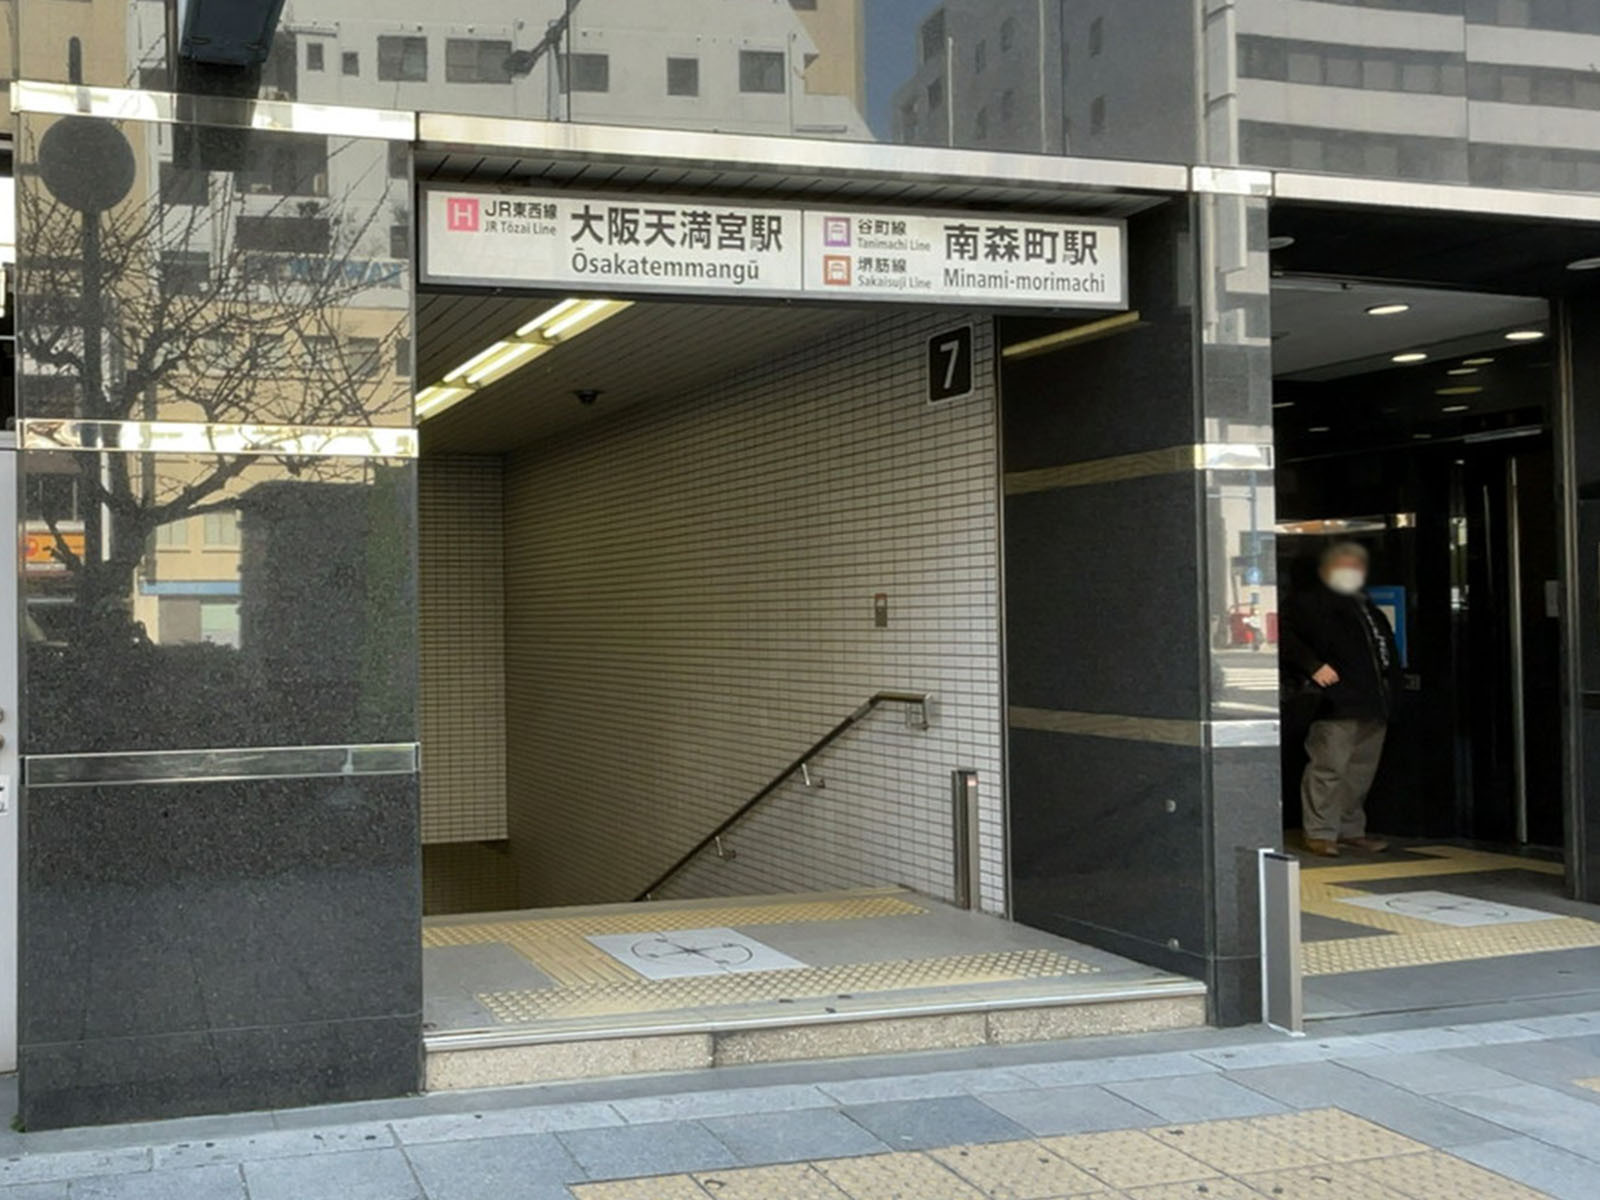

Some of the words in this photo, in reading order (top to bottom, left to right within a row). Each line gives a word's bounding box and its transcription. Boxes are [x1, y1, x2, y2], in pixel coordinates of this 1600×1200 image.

[452, 200, 474, 228] H
[484, 200, 558, 220] JR東西線
[485, 221, 498, 233] JR
[533, 222, 557, 236] Line
[570, 205, 783, 253] 大阪天満宮駅
[857, 218, 907, 236] 谷町線
[858, 238, 908, 251] Tanimachi
[910, 239, 931, 252] Line
[943, 224, 1099, 265] 南森町駅
[571, 248, 760, 284] Ōsakatemmangū
[858, 256, 907, 273] 堺筋線
[858, 275, 907, 290] Sakaisuji
[909, 277, 932, 289] Line
[943, 268, 1106, 293] Minami-morimachi
[940, 340, 960, 390] 7
